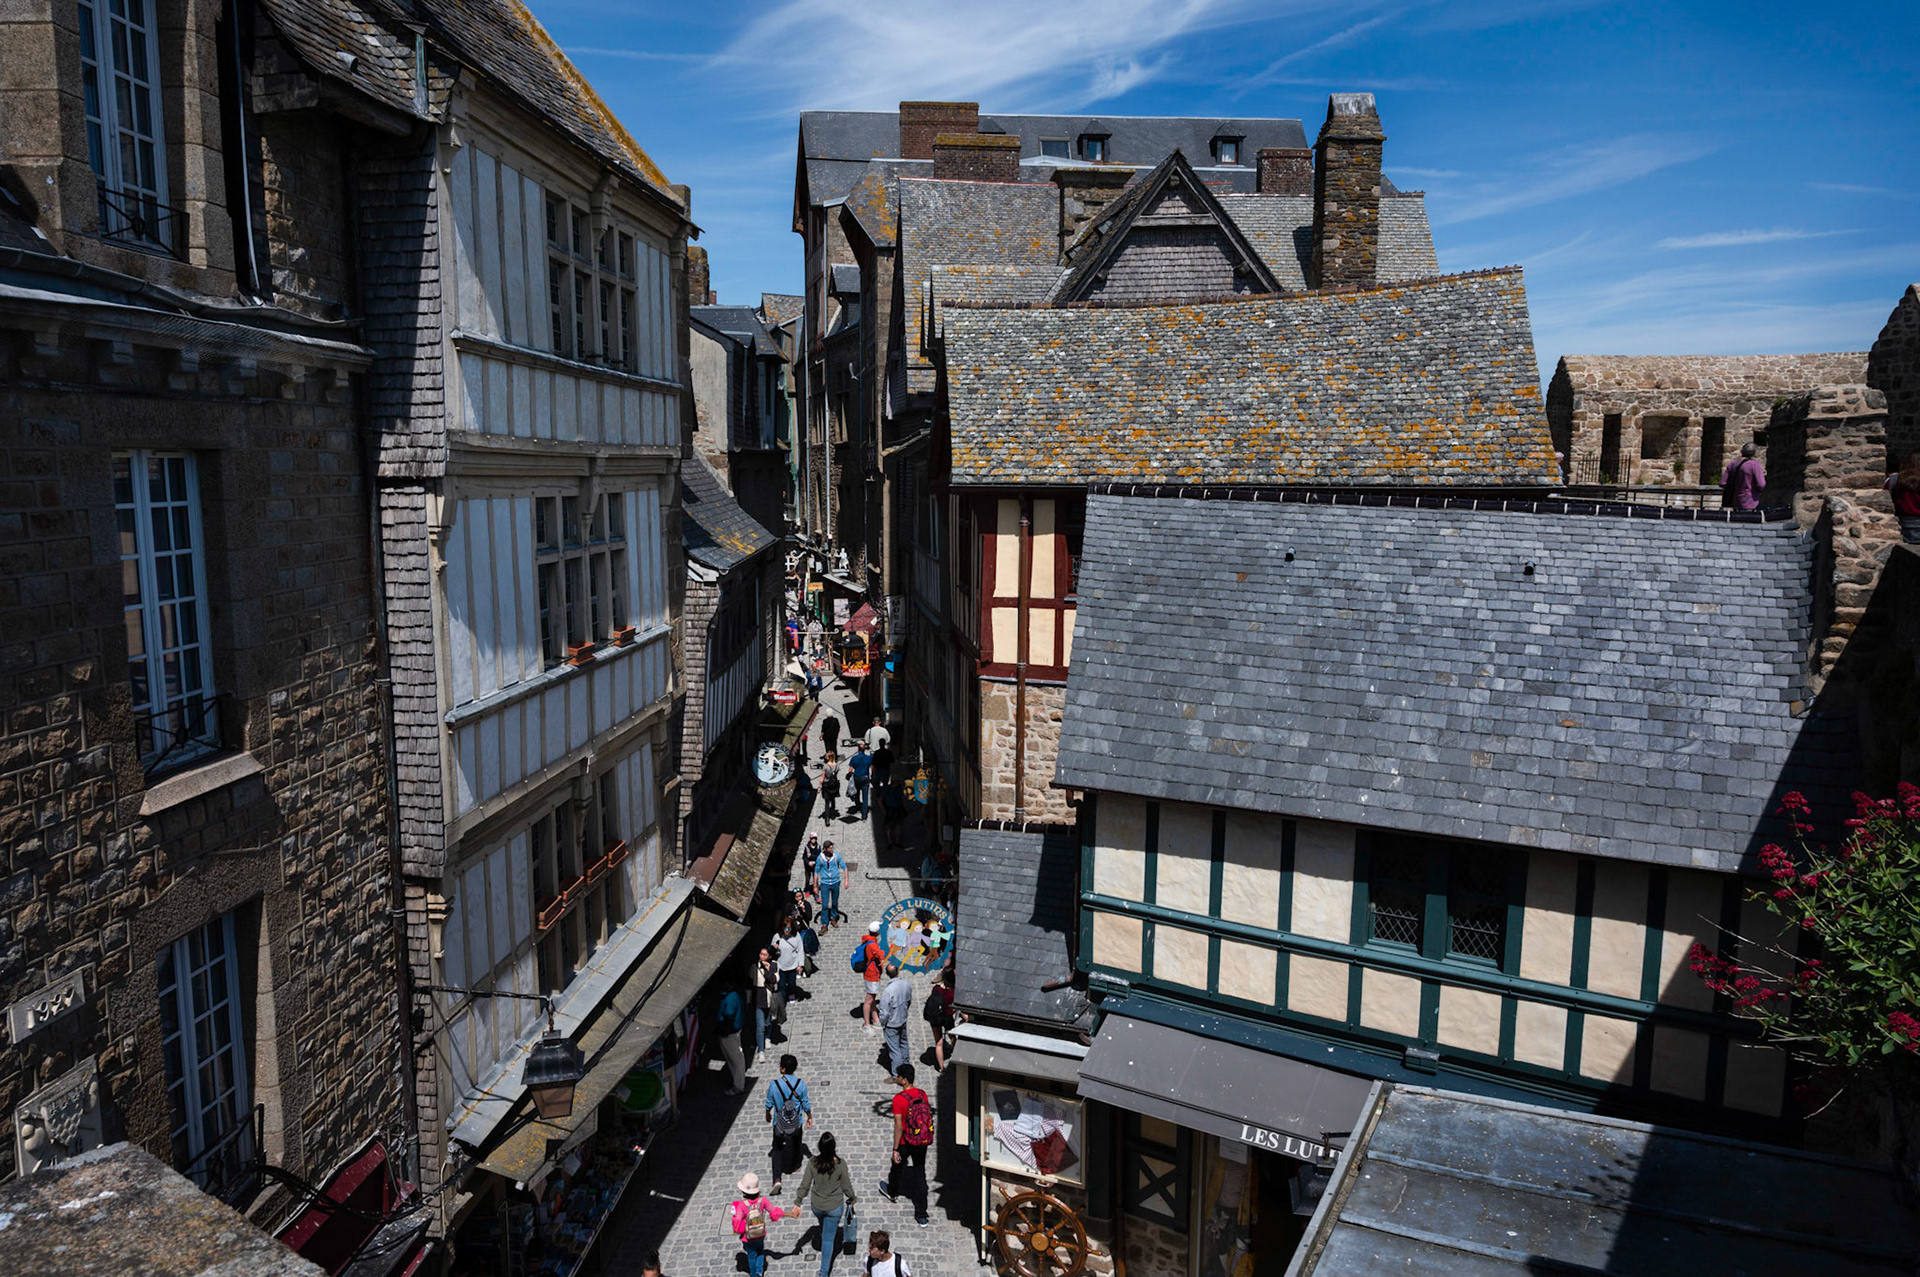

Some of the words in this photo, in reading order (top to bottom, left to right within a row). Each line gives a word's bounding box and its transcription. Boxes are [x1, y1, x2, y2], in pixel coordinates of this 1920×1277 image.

[884, 904, 904, 921] LES
[907, 900, 948, 919] LUTINS
[1239, 1124, 1280, 1149] LES
[1283, 1136, 1342, 1159] LUT
